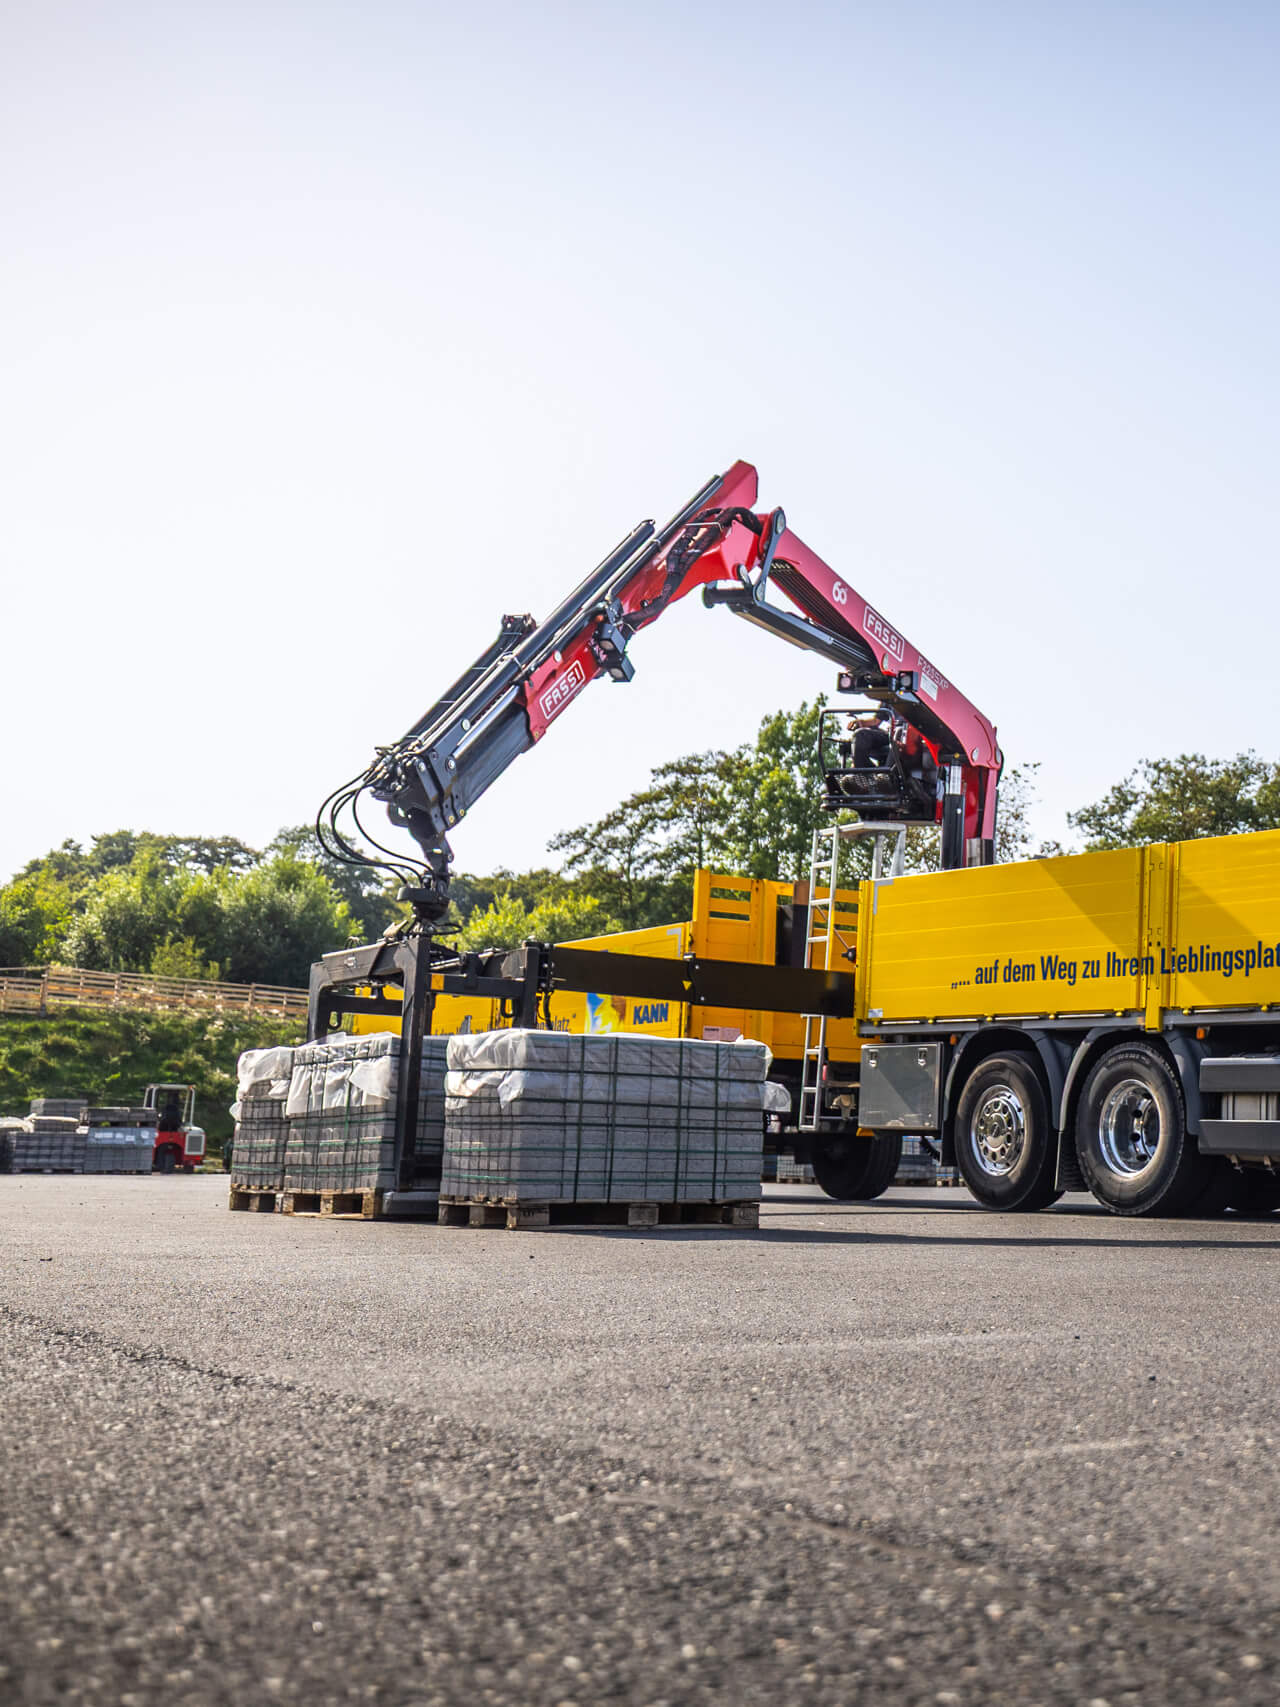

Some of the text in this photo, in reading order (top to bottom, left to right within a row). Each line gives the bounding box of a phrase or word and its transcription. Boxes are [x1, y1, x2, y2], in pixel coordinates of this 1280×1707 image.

[866, 613, 901, 655] FASSI
[545, 667, 581, 713] FASSI
[975, 959, 999, 985] auf
[1003, 958, 1035, 983] dem
[1040, 954, 1077, 986] Weg
[1081, 959, 1100, 979] zu
[1106, 951, 1154, 978] Ihrem
[633, 1003, 669, 1026] KANN
